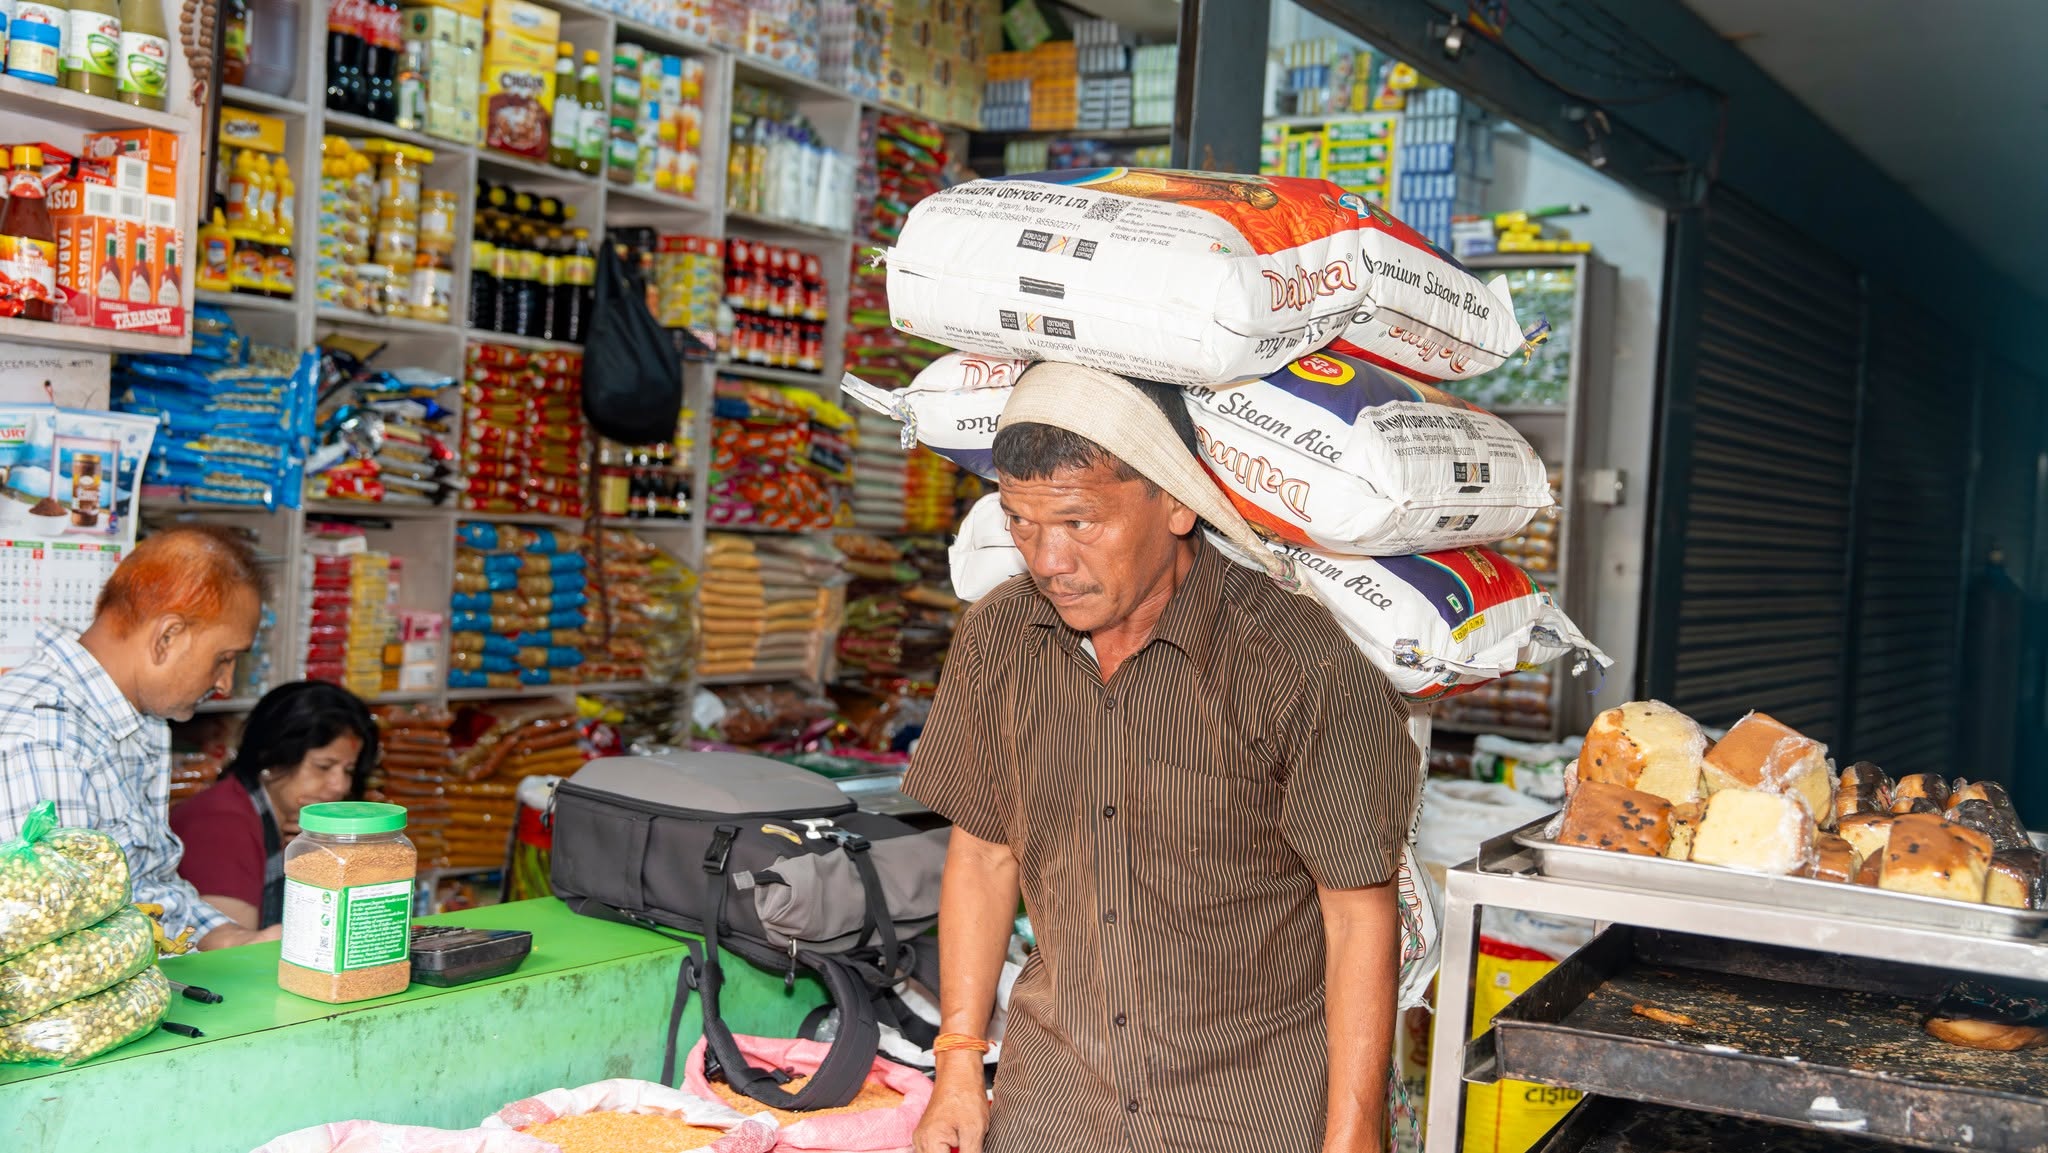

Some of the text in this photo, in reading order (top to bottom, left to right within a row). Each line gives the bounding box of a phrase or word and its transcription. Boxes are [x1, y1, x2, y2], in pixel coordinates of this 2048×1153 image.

[997, 186, 1043, 201] UDHYOG
[1040, 193, 1067, 205] PVT.
[1065, 197, 1089, 209] LTD.
[1110, 233, 1131, 242] STORE
[1150, 238, 1171, 247] PLACE
[1423, 271, 1460, 308] Steam
[1463, 291, 1490, 320] Rice
[112, 307, 171, 330] TABASCO
[1303, 356, 1329, 371] 25
[1217, 392, 1291, 438] Steam
[1293, 429, 1343, 463] Rice
[1194, 425, 1312, 522] Dalim
[1344, 574, 1394, 611] Rice
